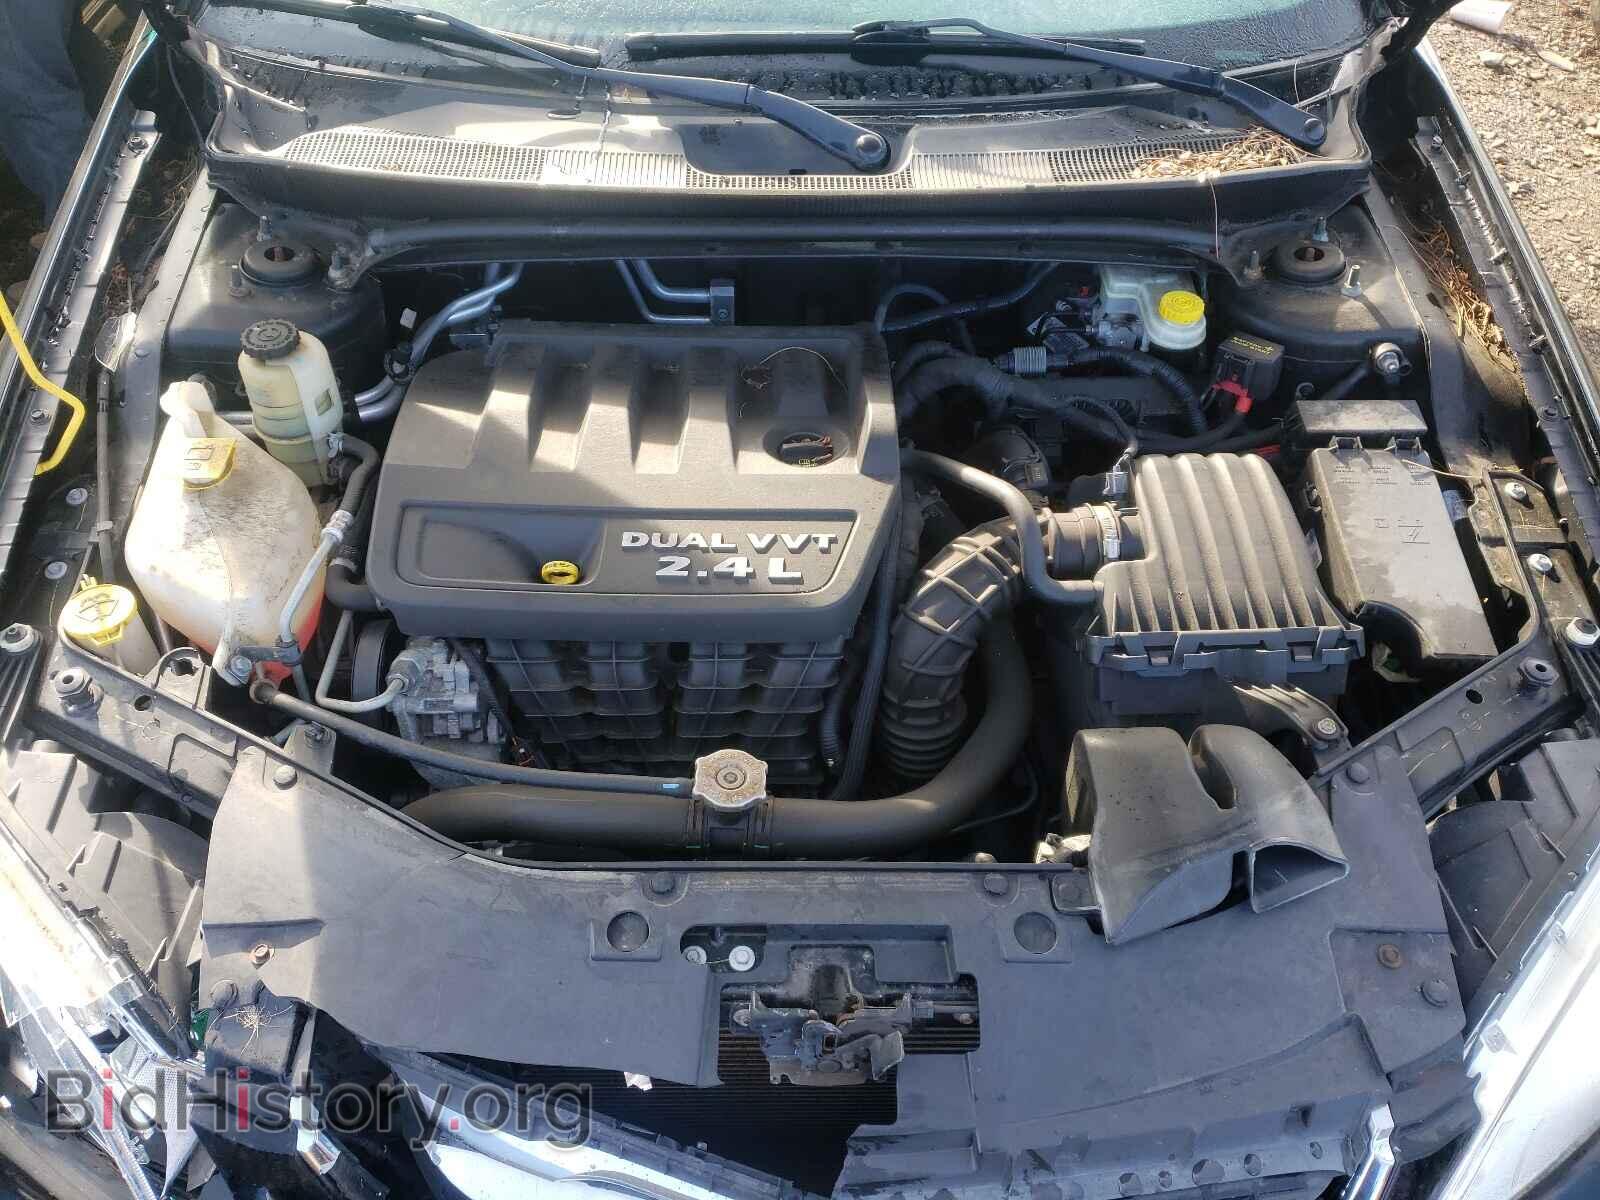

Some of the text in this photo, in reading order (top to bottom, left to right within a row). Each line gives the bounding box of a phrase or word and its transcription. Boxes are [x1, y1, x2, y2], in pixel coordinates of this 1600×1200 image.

[622, 531, 838, 554] DUAL VVT
[655, 555, 804, 585] 2.4 L
